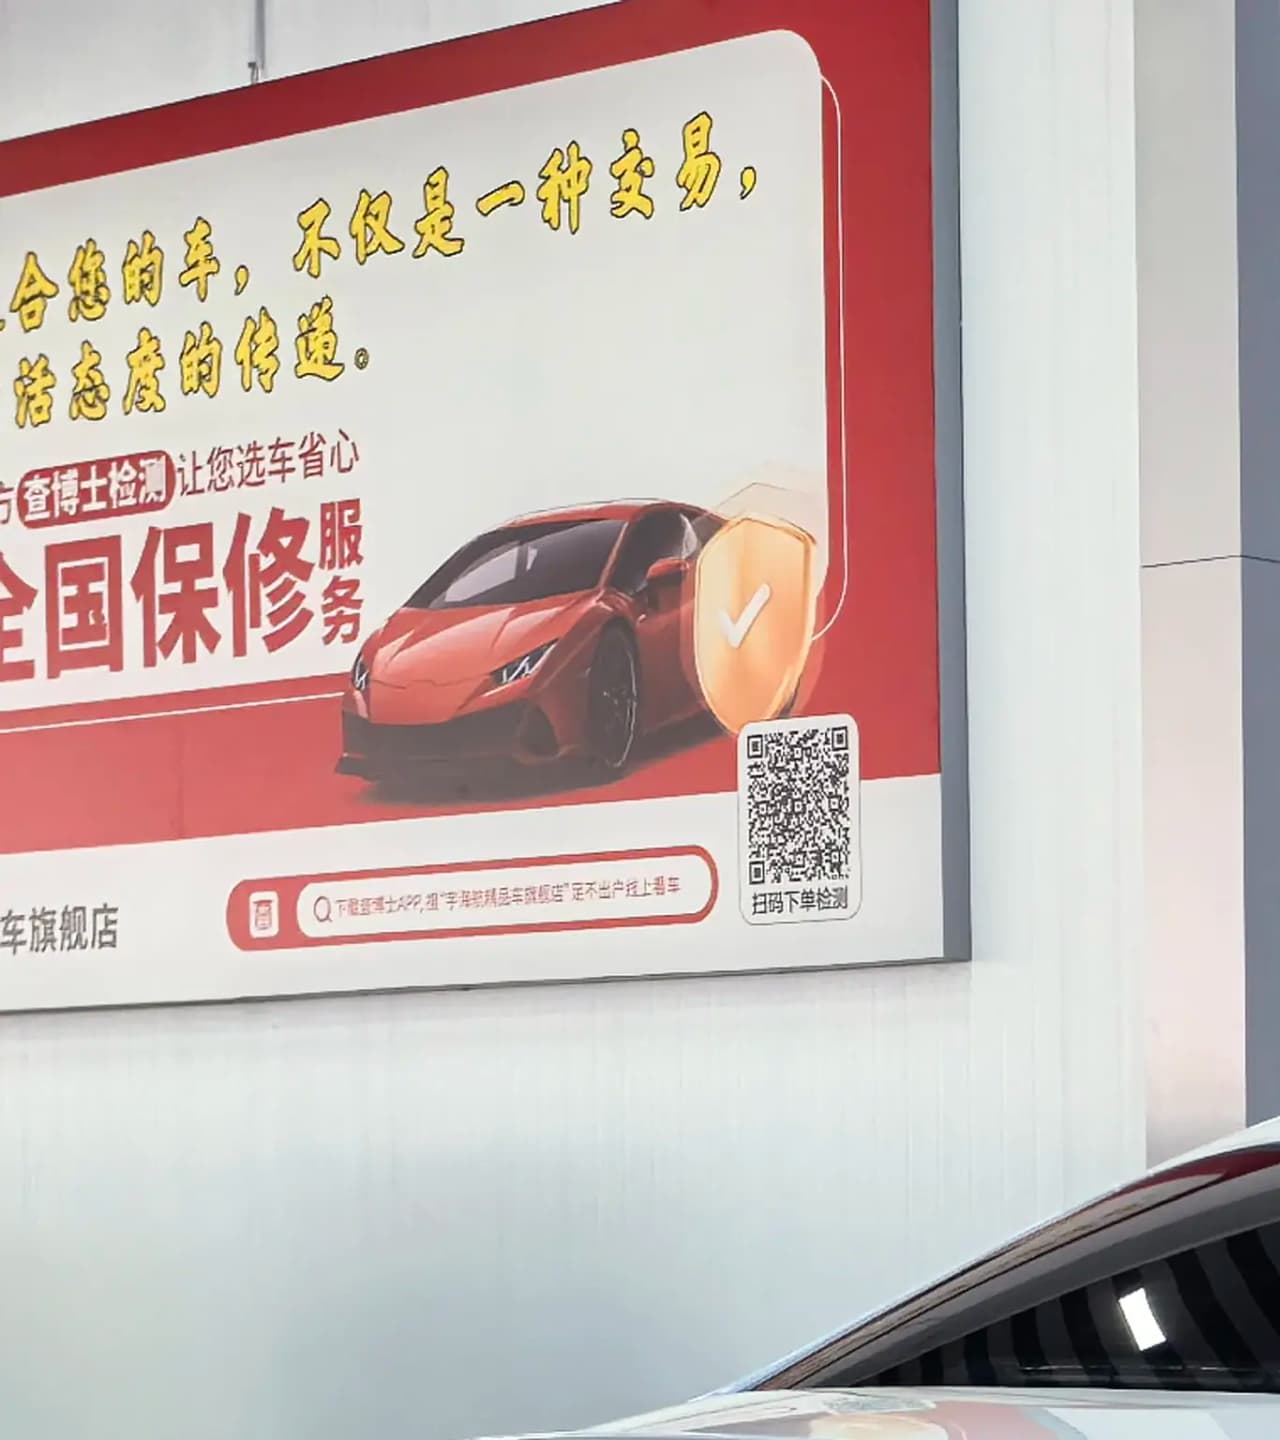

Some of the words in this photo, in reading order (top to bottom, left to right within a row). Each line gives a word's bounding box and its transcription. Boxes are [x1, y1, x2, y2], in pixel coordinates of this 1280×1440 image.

[0, 111, 758, 332] 合您的车，不仅是一种交易，
[319, 497, 364, 646] 服务
[0, 902, 118, 956] 车旗舰店
[752, 884, 848, 915] 扫码下单检测
